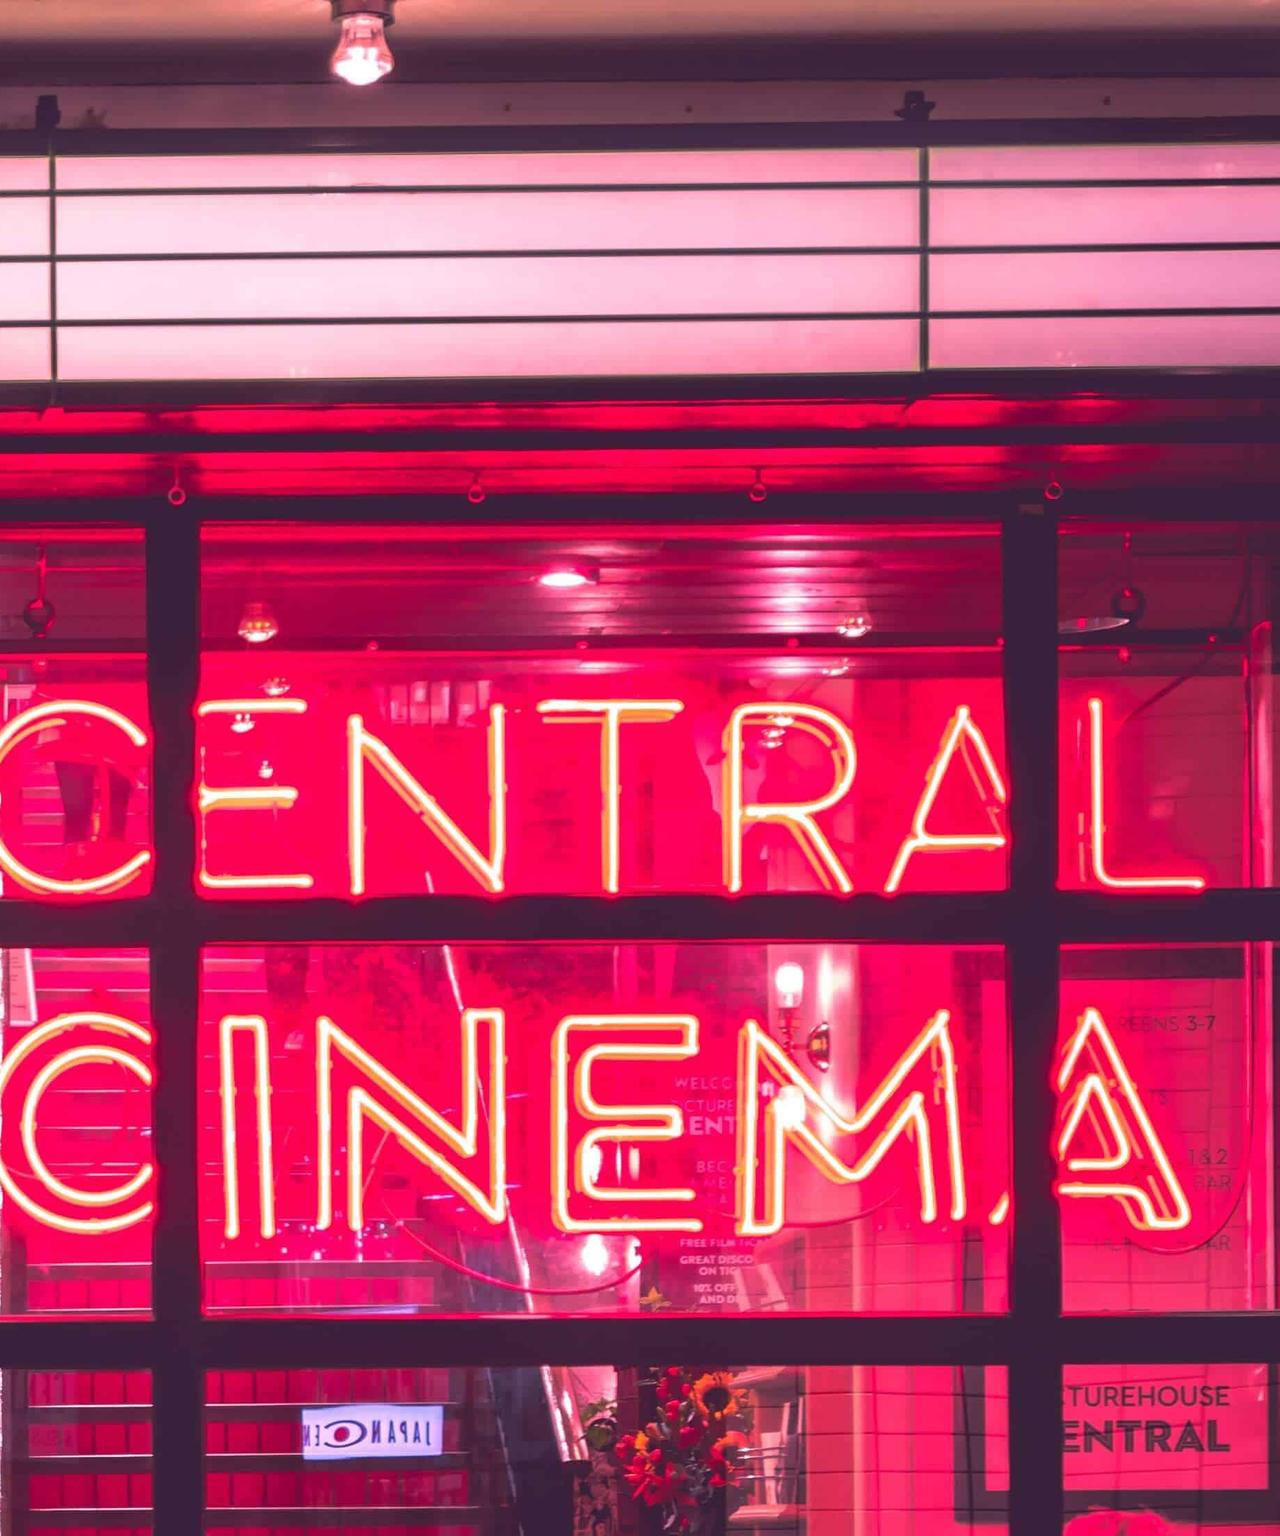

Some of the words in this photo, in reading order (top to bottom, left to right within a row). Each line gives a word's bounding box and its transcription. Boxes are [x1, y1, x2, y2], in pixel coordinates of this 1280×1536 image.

[1186, 1015, 1216, 1032] 3-7
[680, 1255, 716, 1265] GREAT
[1062, 1385, 1230, 1407] TUREHOUSE
[1062, 1420, 1230, 1452] ENTRAL
